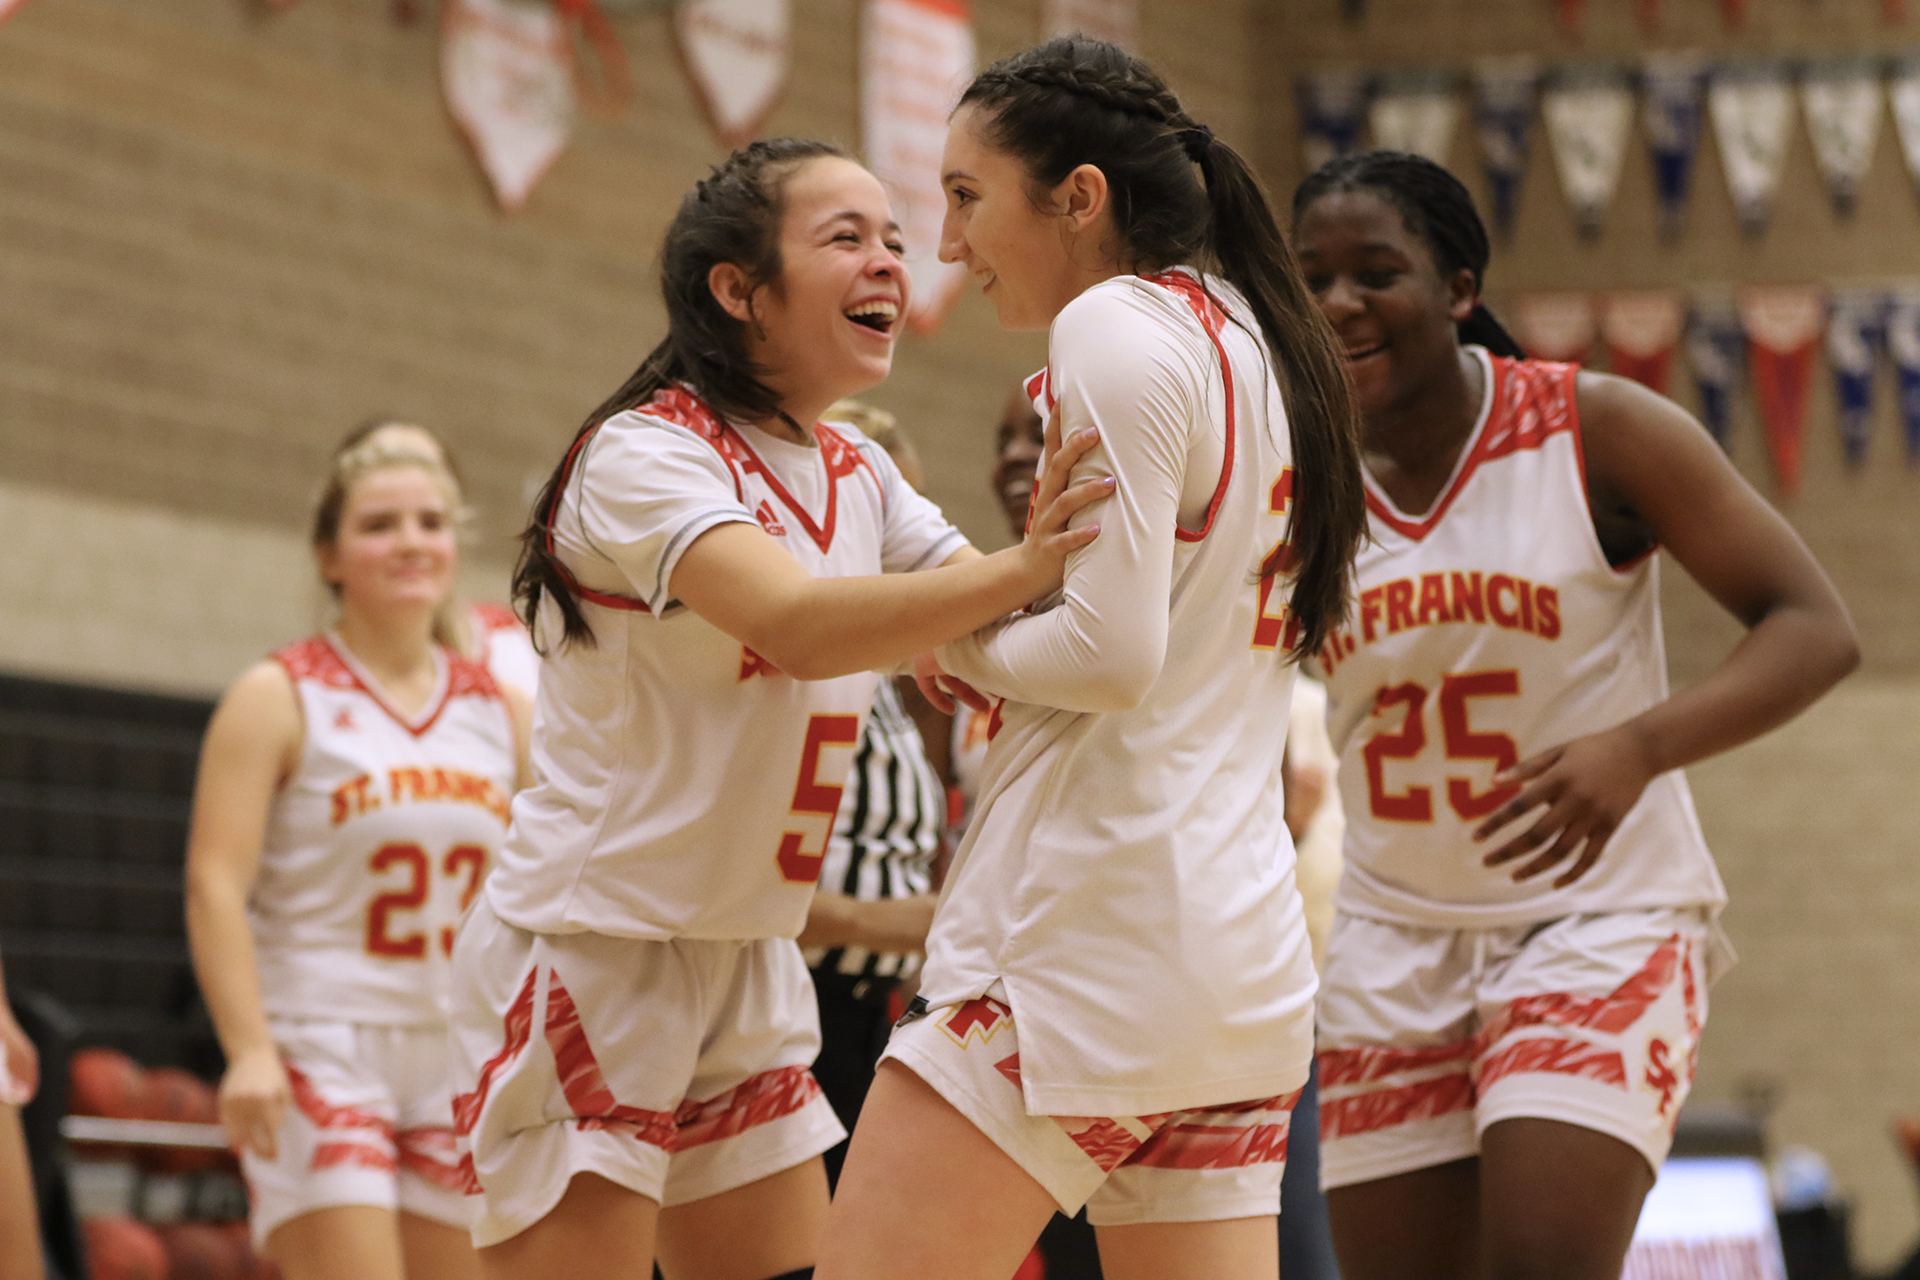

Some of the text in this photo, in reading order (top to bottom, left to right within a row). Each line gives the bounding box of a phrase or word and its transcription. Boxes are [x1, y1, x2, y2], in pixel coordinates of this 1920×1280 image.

[1359, 569, 1563, 644] FRANCIS
[330, 773, 380, 829] ST.
[775, 712, 860, 885] 5
[1362, 668, 1524, 824] 25
